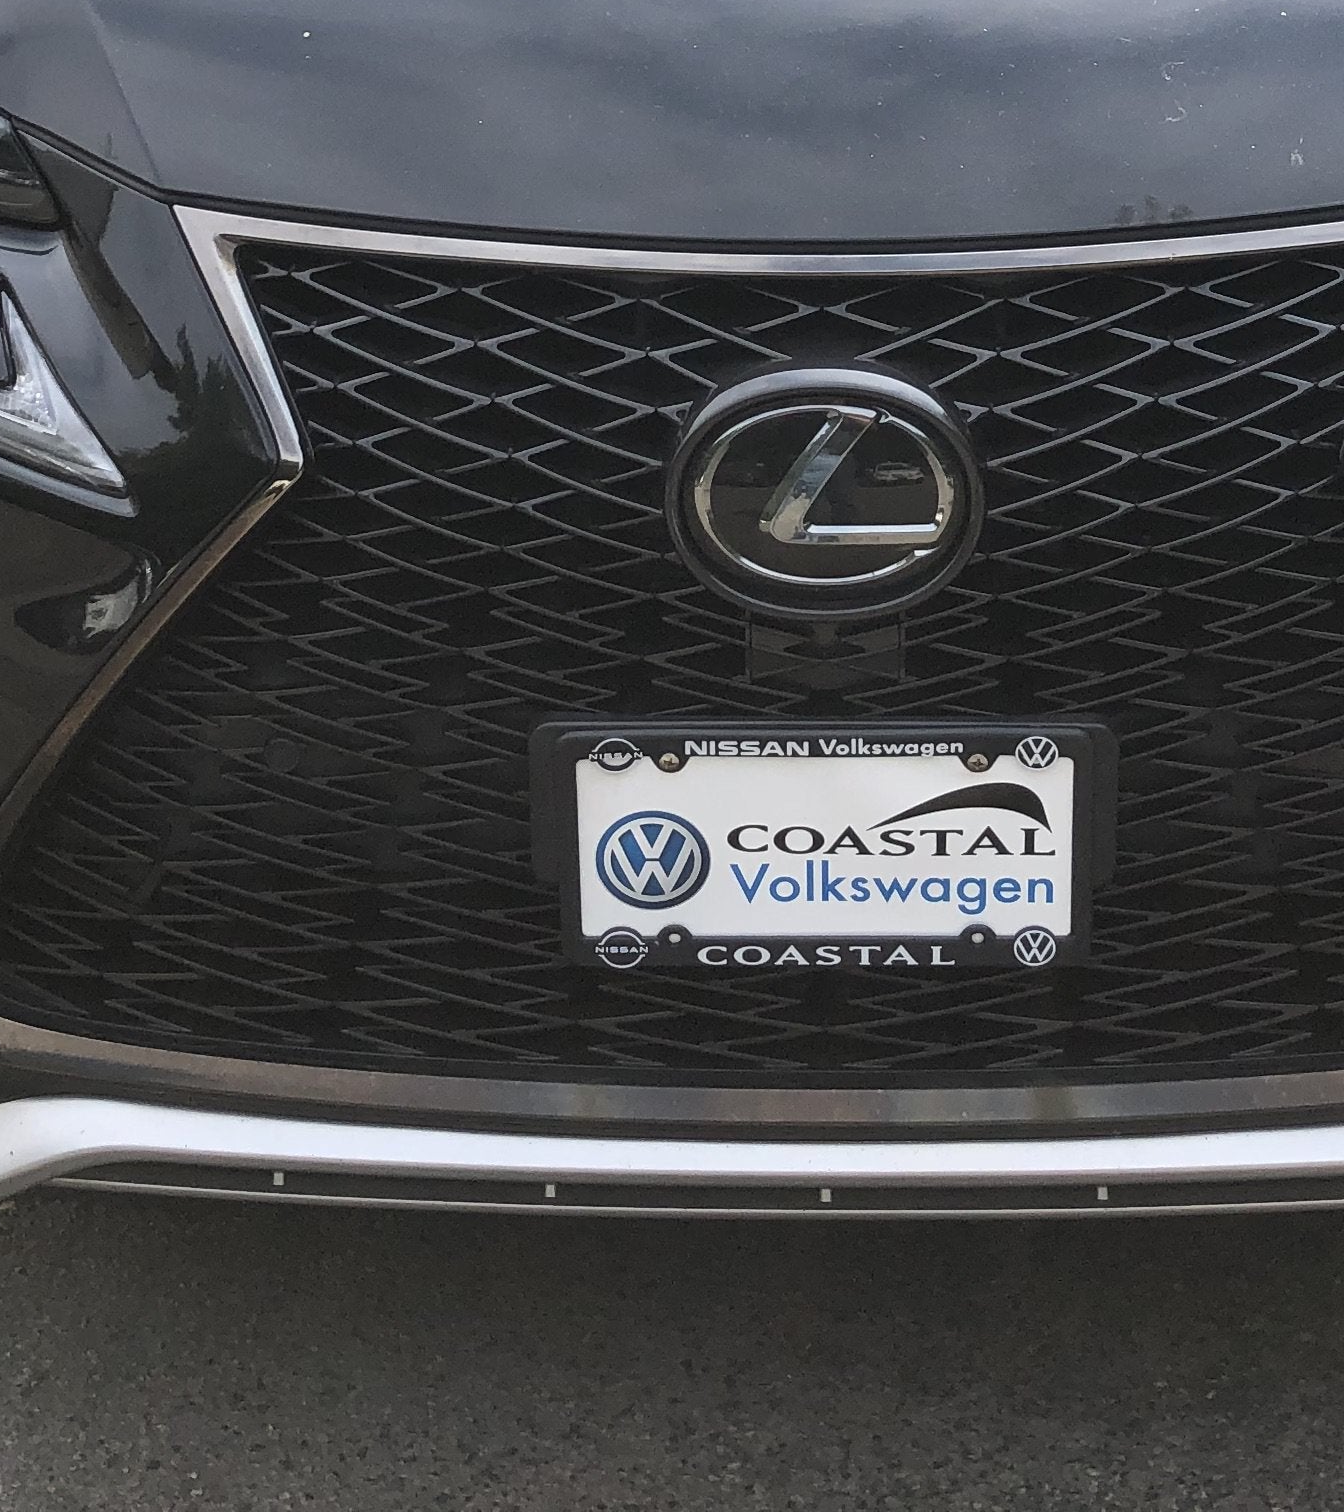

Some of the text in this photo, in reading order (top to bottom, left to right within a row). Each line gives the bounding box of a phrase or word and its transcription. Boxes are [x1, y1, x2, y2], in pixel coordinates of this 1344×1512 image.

[684, 737, 965, 758] NISSAN Volkswagen
[726, 825, 1056, 857] COASTAL
[730, 859, 1055, 916] Volkswagen
[595, 945, 649, 954] NISSAN
[697, 944, 956, 966] COASTAL
